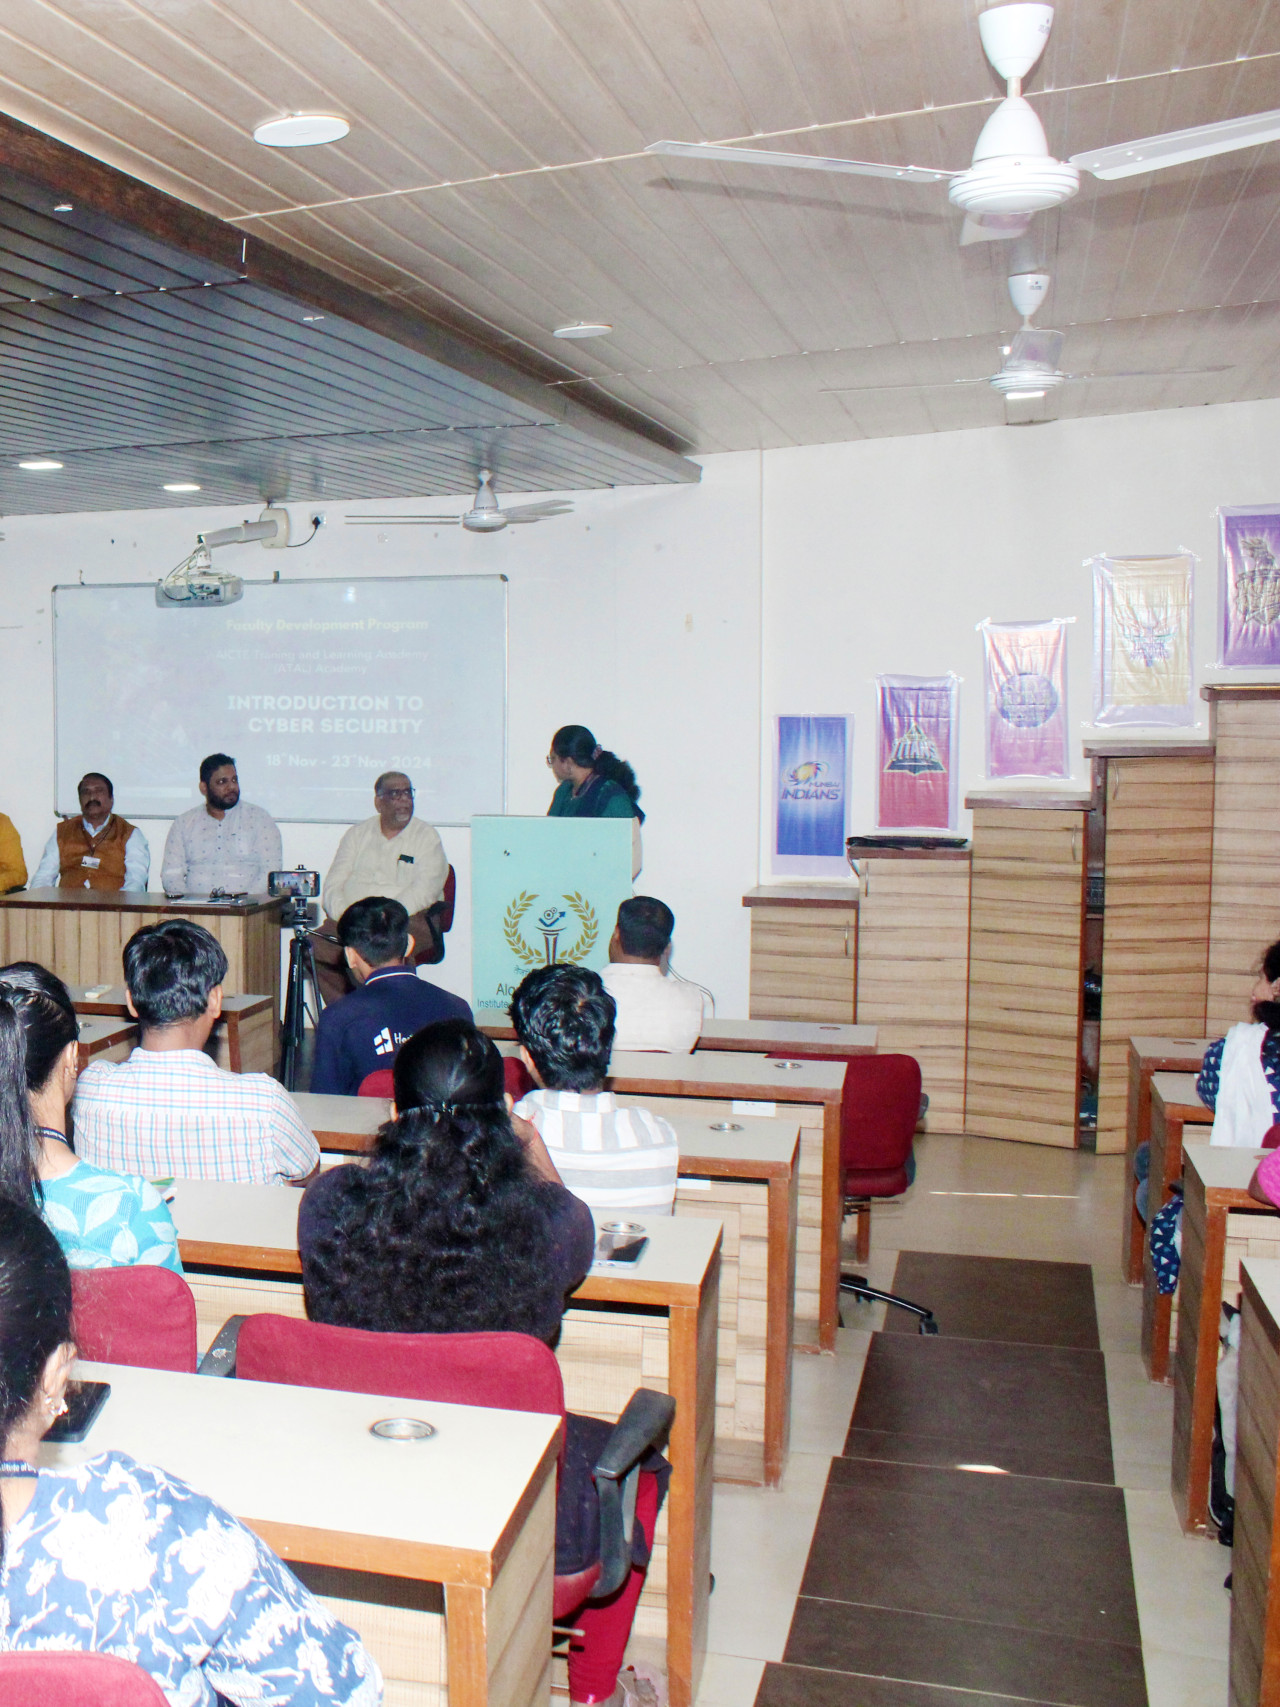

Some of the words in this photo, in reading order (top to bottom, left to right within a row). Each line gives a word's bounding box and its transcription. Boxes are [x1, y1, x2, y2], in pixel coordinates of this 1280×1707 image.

[226, 619, 273, 634] Faculty
[276, 619, 365, 633] Development
[367, 618, 429, 633] Program
[316, 663, 368, 675] Academy
[227, 695, 389, 711] INTRODUCTION
[395, 695, 424, 711] TO
[248, 717, 314, 733] CYBER
[320, 717, 424, 733] SECURITY
[891, 739, 939, 760] TITANS
[289, 754, 318, 767] Nov
[358, 755, 387, 768] Nov
[391, 755, 432, 769] 2024
[781, 787, 841, 800] INDIANS
